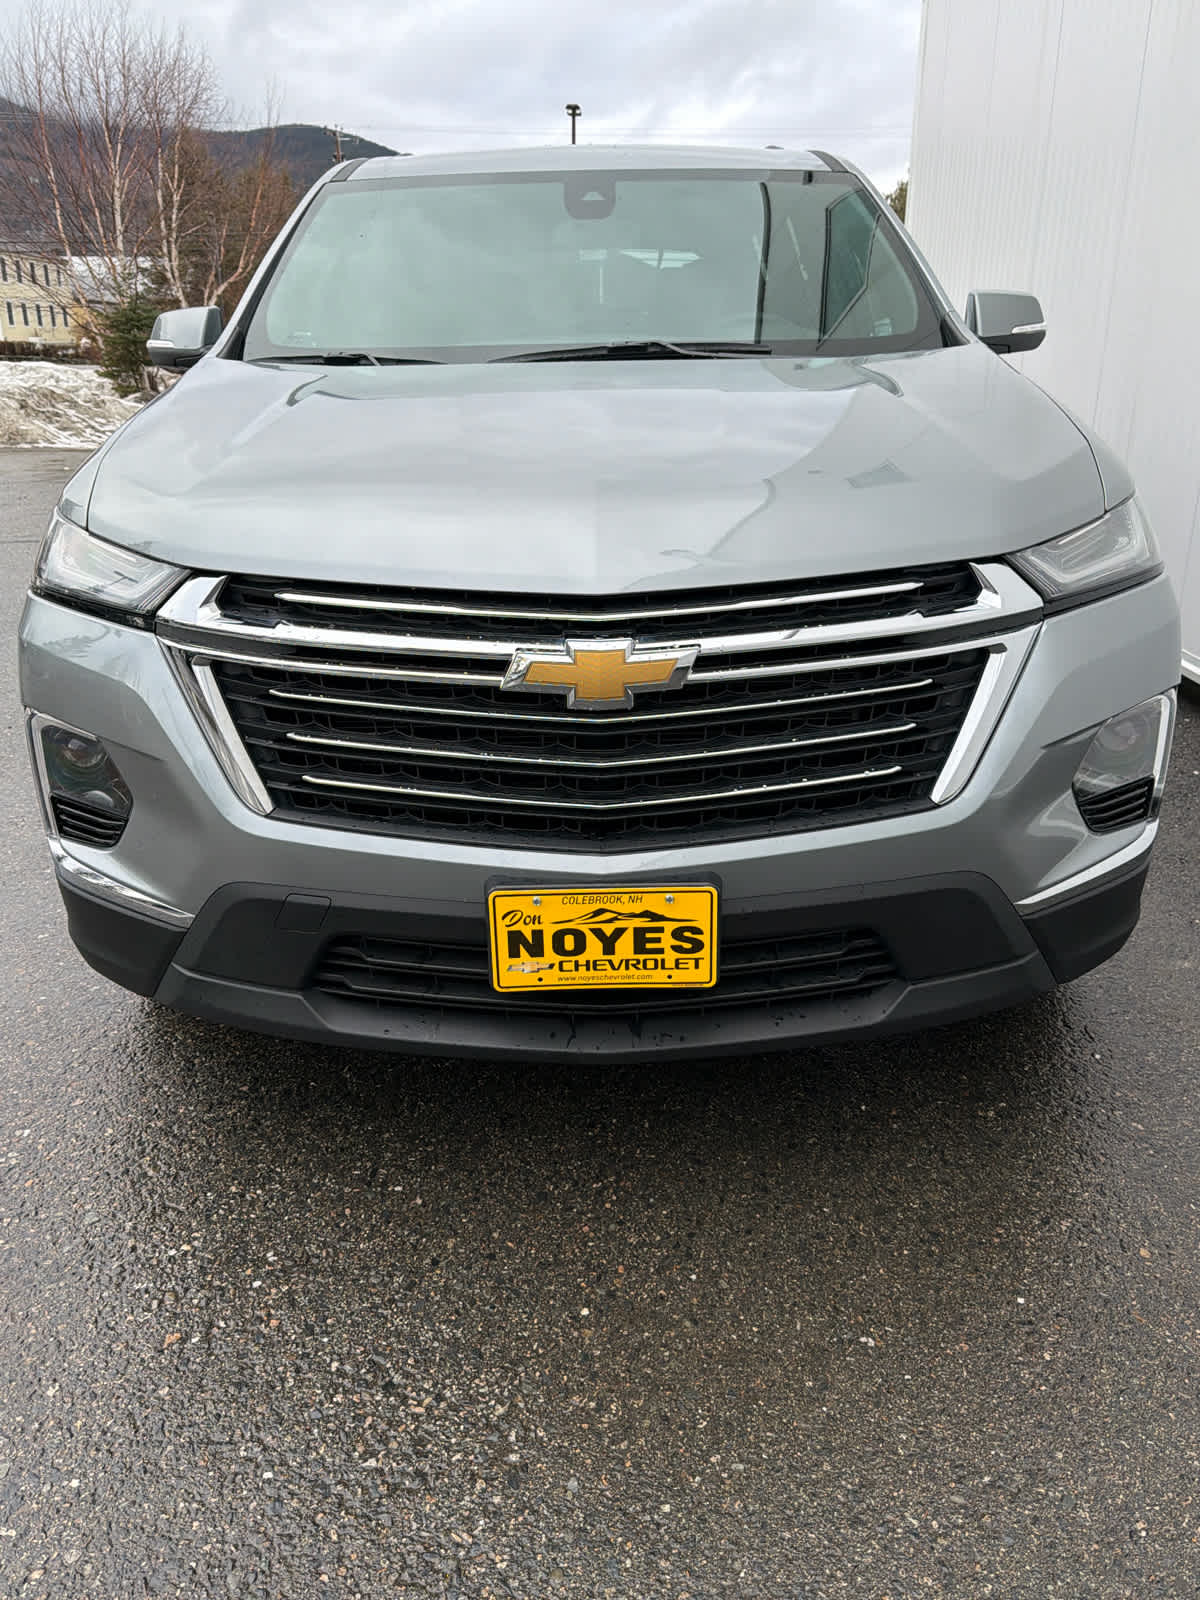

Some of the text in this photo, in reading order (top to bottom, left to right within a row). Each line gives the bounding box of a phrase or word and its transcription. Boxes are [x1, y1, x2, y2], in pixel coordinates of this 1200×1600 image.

[561, 895, 644, 905] COLEBROOK, NH
[501, 909, 543, 928] Don
[507, 925, 705, 959] NOYES
[558, 957, 705, 973] CHEVROLET
[557, 973, 653, 983] www.noyeschevrolet.com
